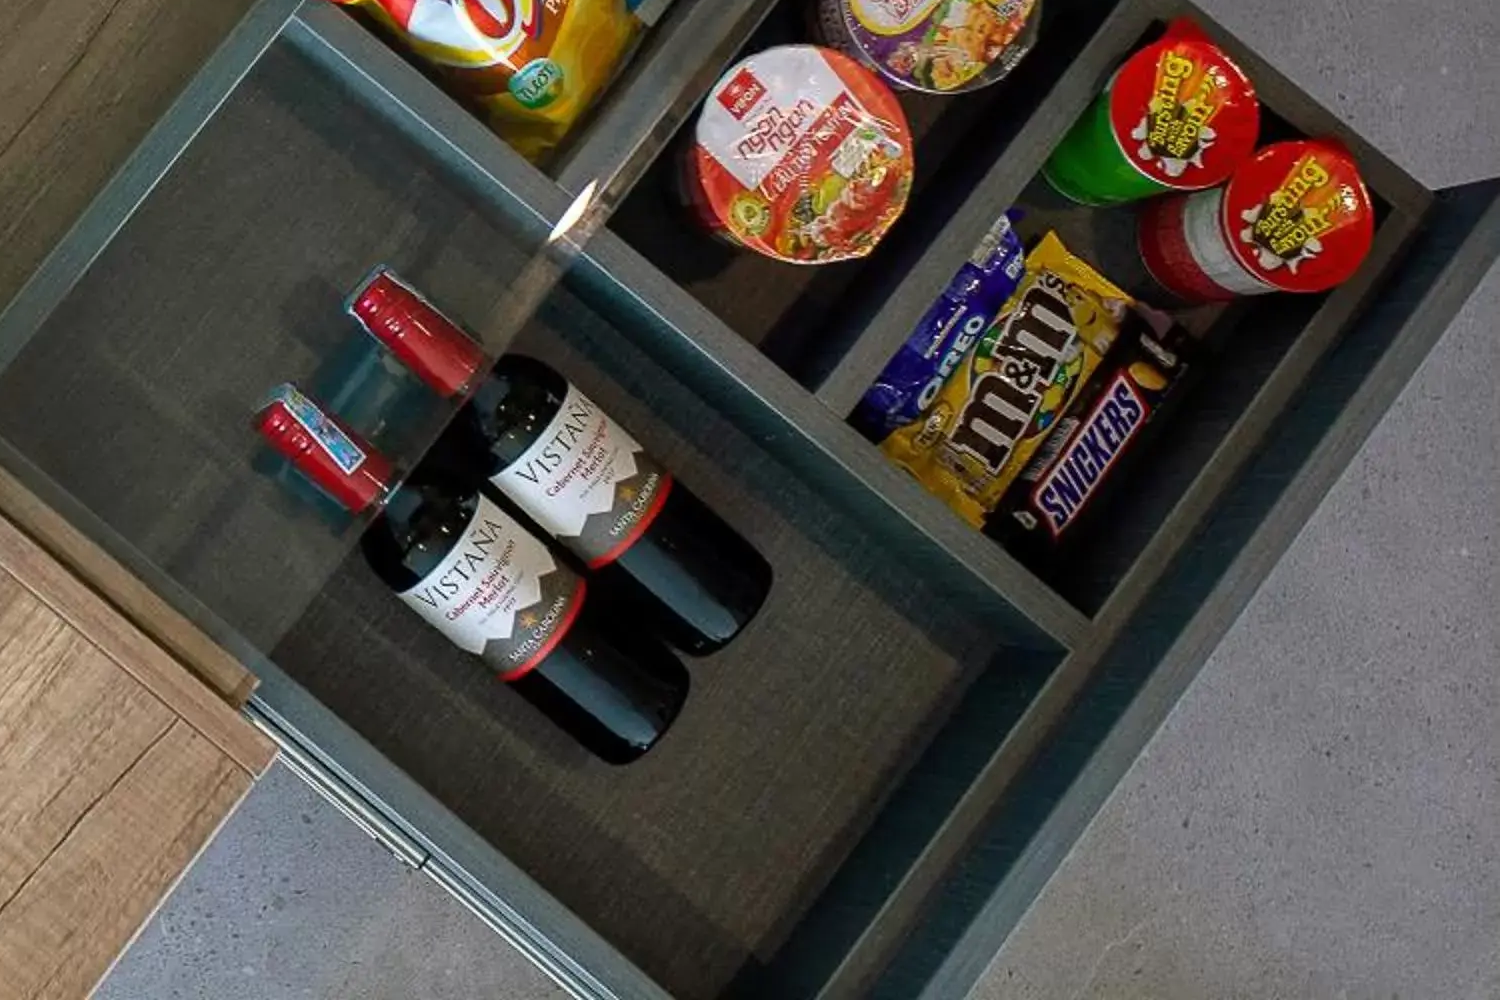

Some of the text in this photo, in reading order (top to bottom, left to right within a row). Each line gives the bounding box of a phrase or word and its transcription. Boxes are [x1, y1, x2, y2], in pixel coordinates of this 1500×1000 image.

[918, 315, 985, 410] OREO
[545, 458, 587, 498] Cabernet
[580, 446, 606, 481] Merlot
[1038, 381, 1144, 528] SNICKERS
[413, 519, 502, 610] VISTAÑA
[445, 585, 483, 621] Cabernet
[481, 538, 516, 588] Sauvignon
[478, 574, 510, 610] Merlot
